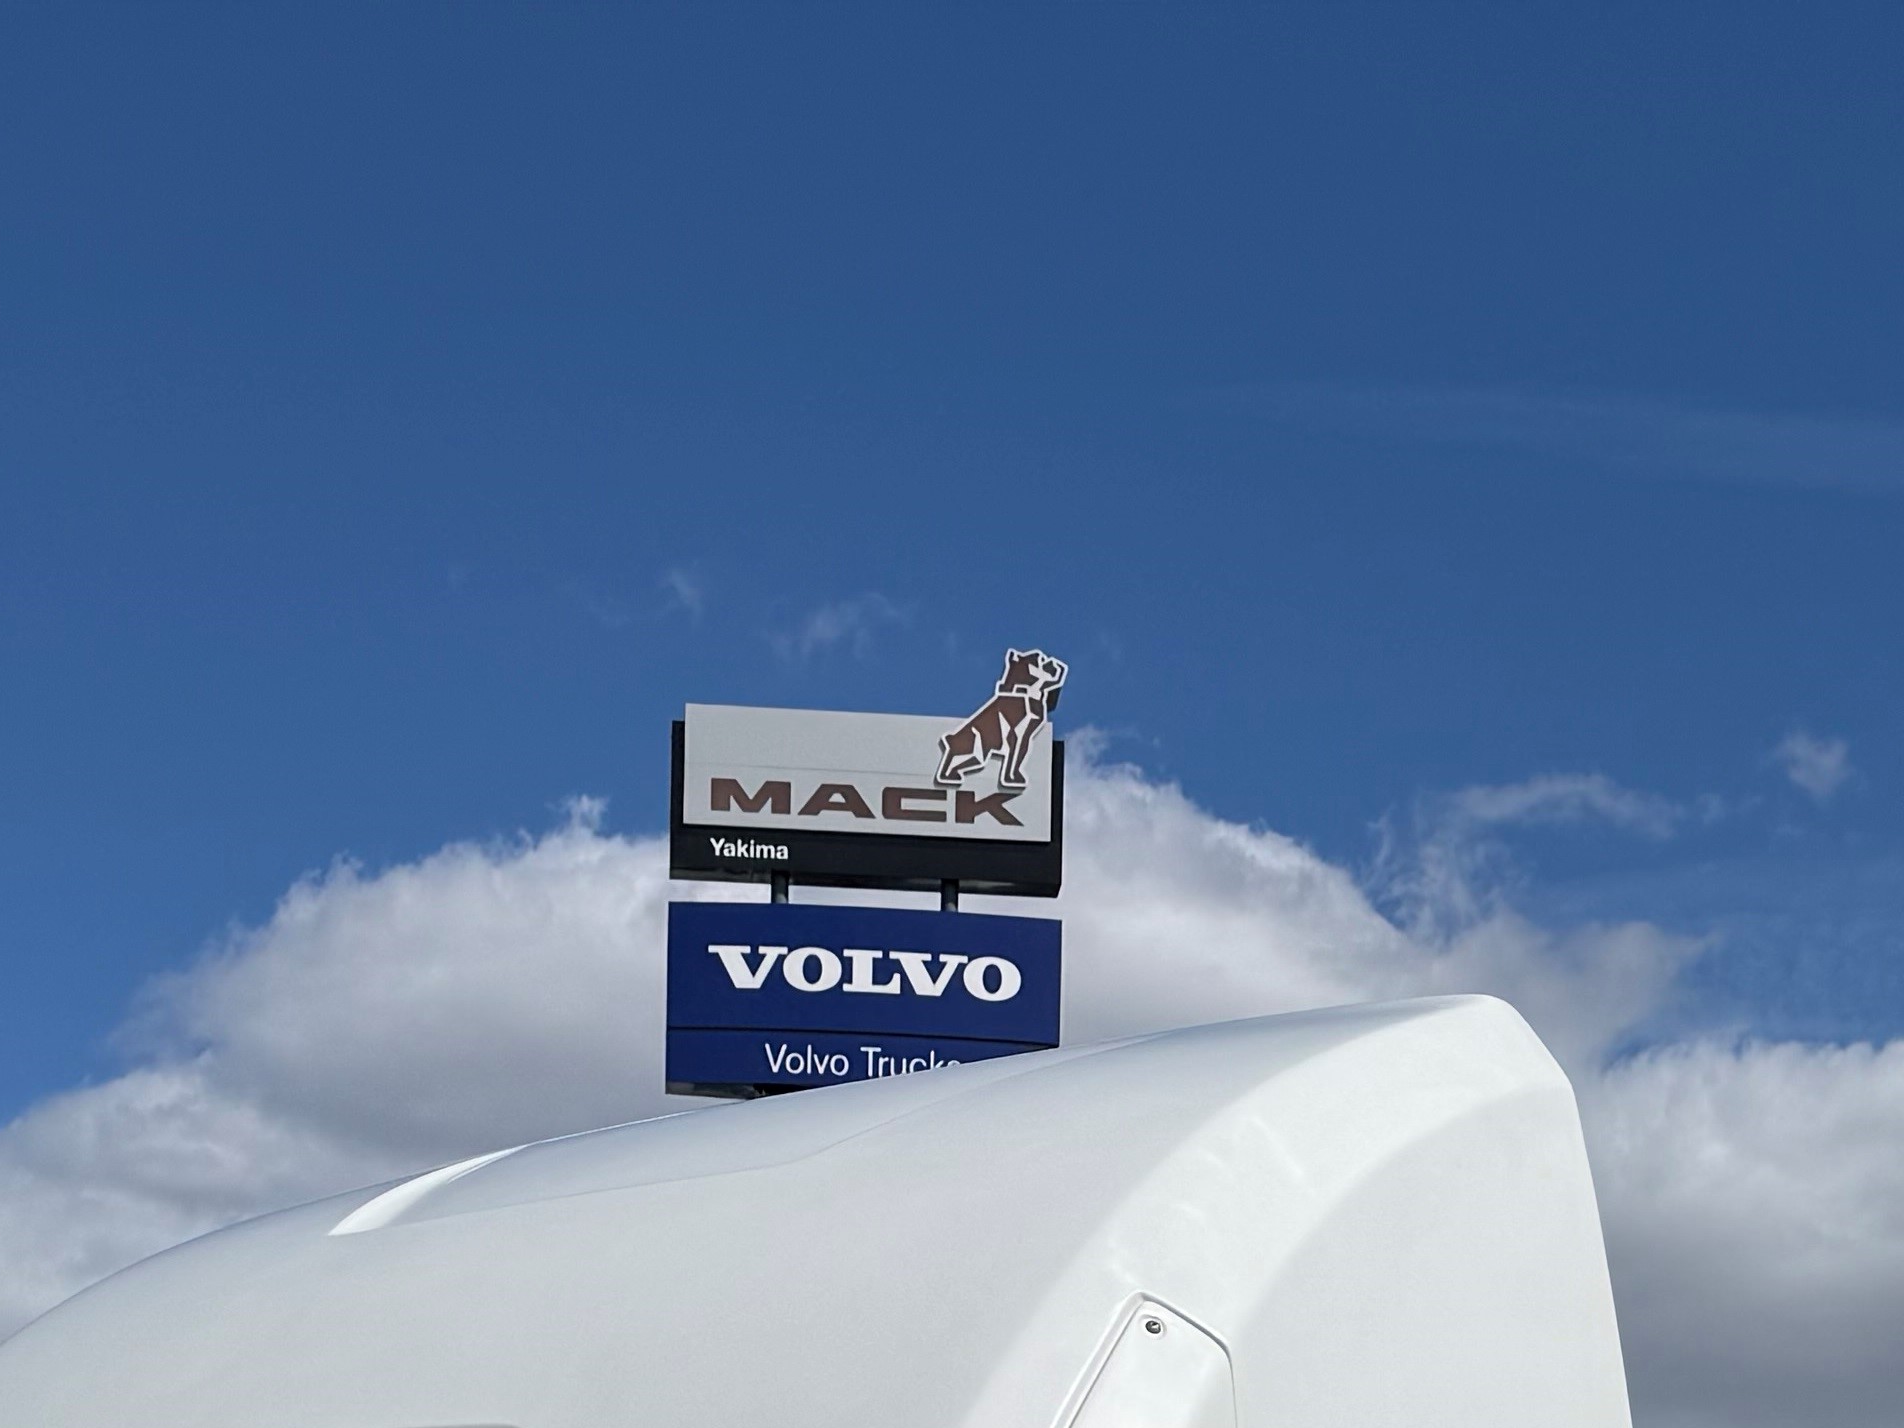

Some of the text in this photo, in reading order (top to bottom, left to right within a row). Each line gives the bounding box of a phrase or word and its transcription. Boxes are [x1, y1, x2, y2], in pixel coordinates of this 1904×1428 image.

[710, 777, 1025, 827] MACK
[709, 837, 789, 860] Yakima
[707, 944, 1022, 1002] VOLVO
[764, 1042, 849, 1076] Volvo
